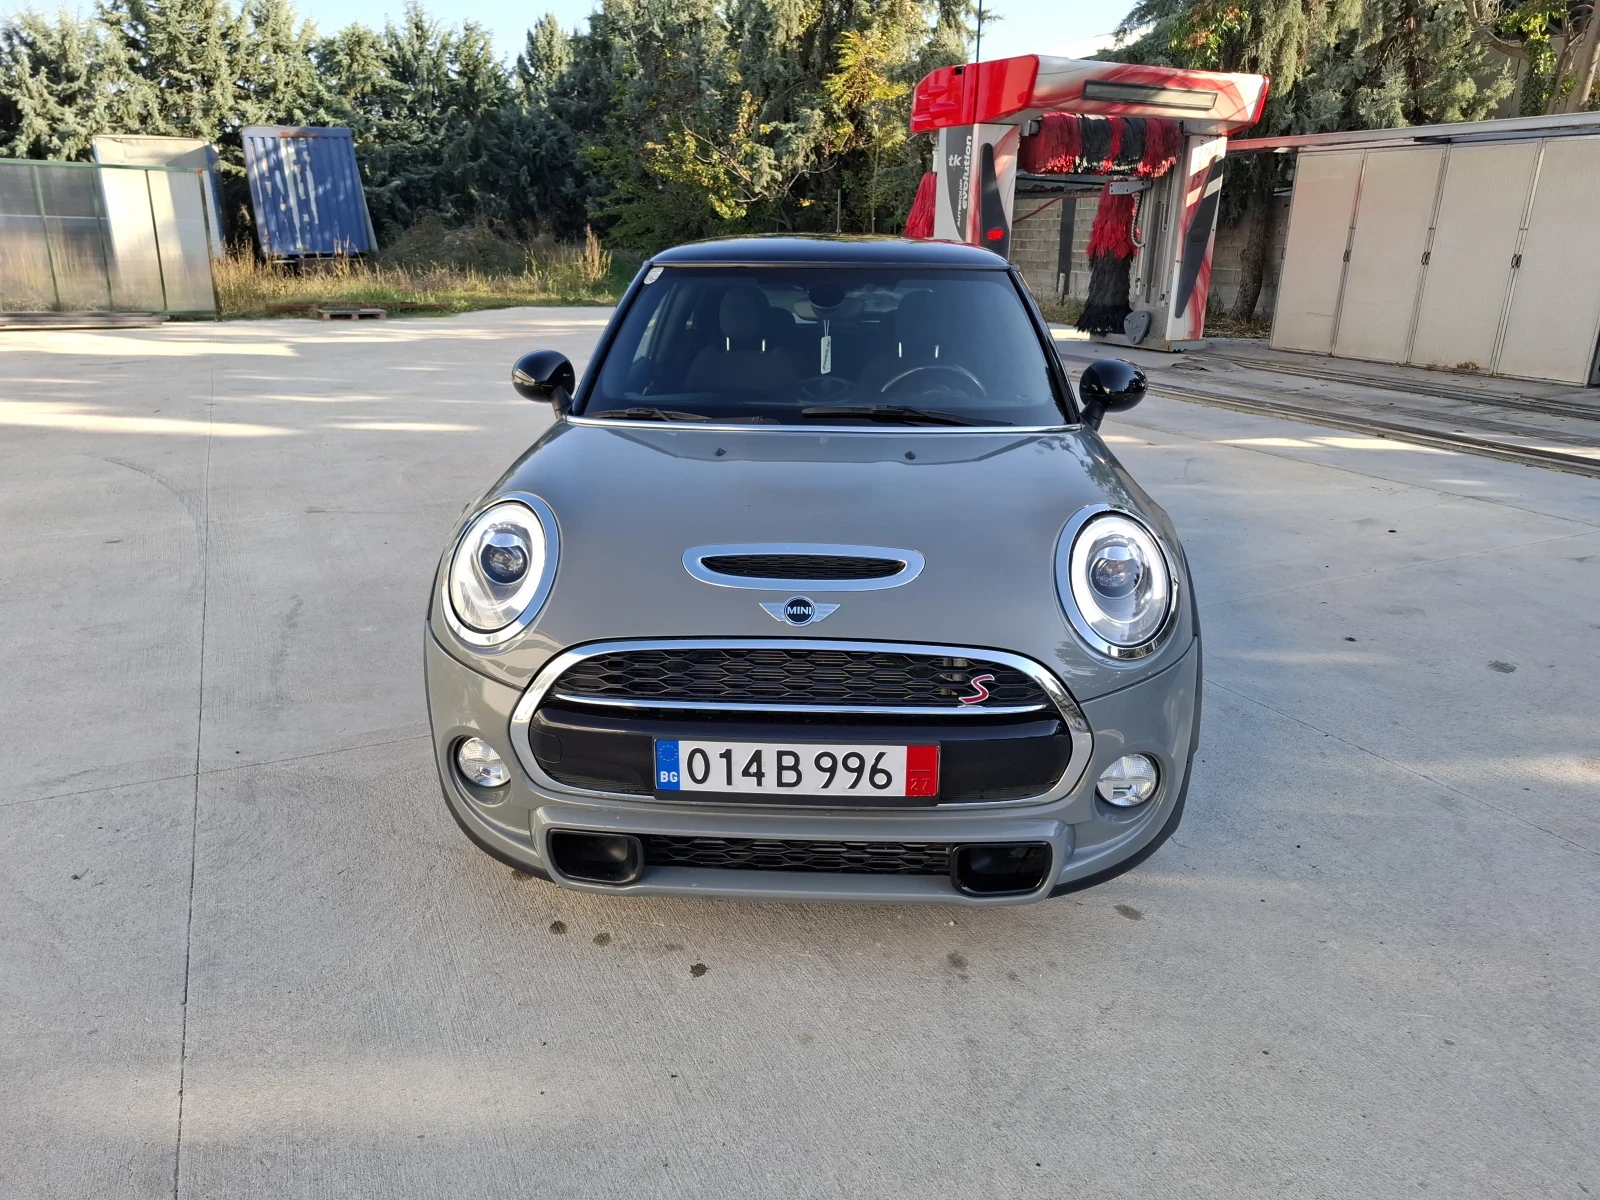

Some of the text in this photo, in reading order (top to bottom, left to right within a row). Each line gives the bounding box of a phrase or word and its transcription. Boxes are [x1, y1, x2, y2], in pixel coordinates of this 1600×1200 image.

[948, 154, 962, 167] tk
[962, 135, 972, 209] evolution
[786, 606, 812, 615] MINI
[958, 673, 995, 704] S
[660, 770, 679, 783] BG
[909, 777, 930, 791] 27
